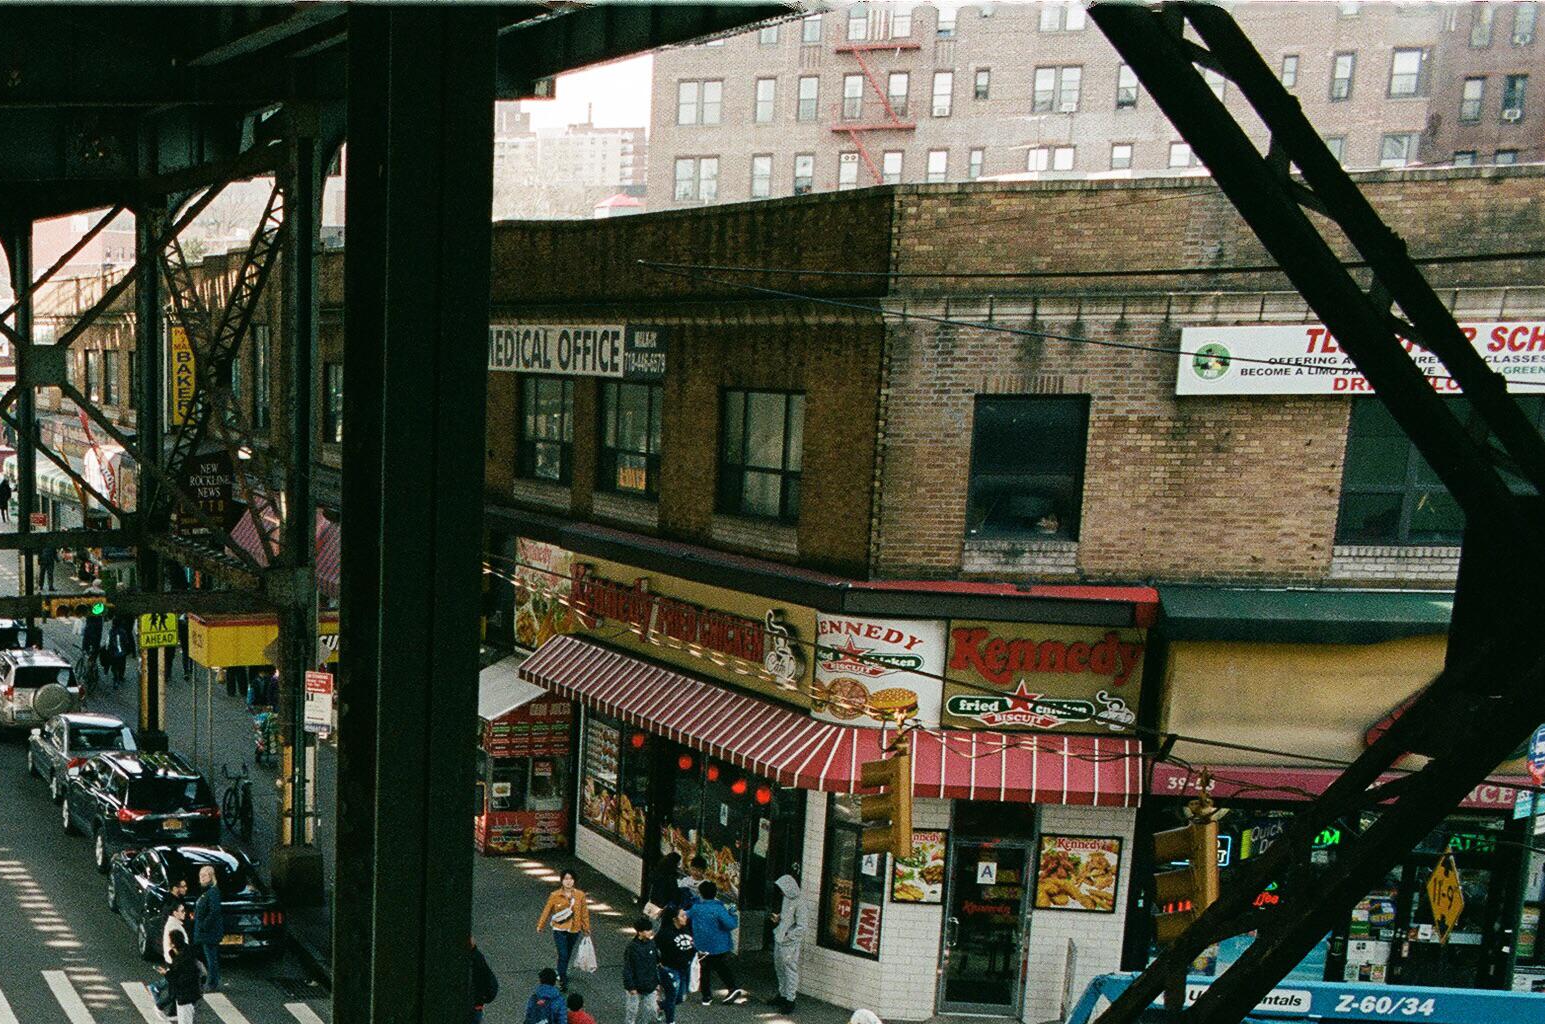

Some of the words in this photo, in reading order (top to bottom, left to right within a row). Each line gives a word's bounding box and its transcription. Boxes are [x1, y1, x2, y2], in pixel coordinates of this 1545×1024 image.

[1306, 328, 1346, 353] TL
[489, 327, 552, 370] EDICAL
[558, 329, 621, 372] OFFICE
[1268, 357, 1338, 366] OFFERING
[1240, 367, 1292, 376] BECOME
[1295, 367, 1304, 375] A
[1307, 367, 1338, 376] LIMO
[200, 463, 219, 474] NEW
[197, 487, 221, 498] NEWS
[145, 633, 175, 645] AHEAD
[817, 620, 924, 650] ENNEDY
[949, 626, 1146, 688] Kennedy
[958, 699, 1000, 712] fried
[994, 711, 1043, 725] BISCUIT
[912, 832, 941, 844] nnedy
[1057, 838, 1102, 851] Kennedy
[980, 866, 993, 879] A
[856, 907, 878, 952] ATM
[1258, 995, 1302, 1007] ntals
[1335, 994, 1436, 1017] Z-60/34
